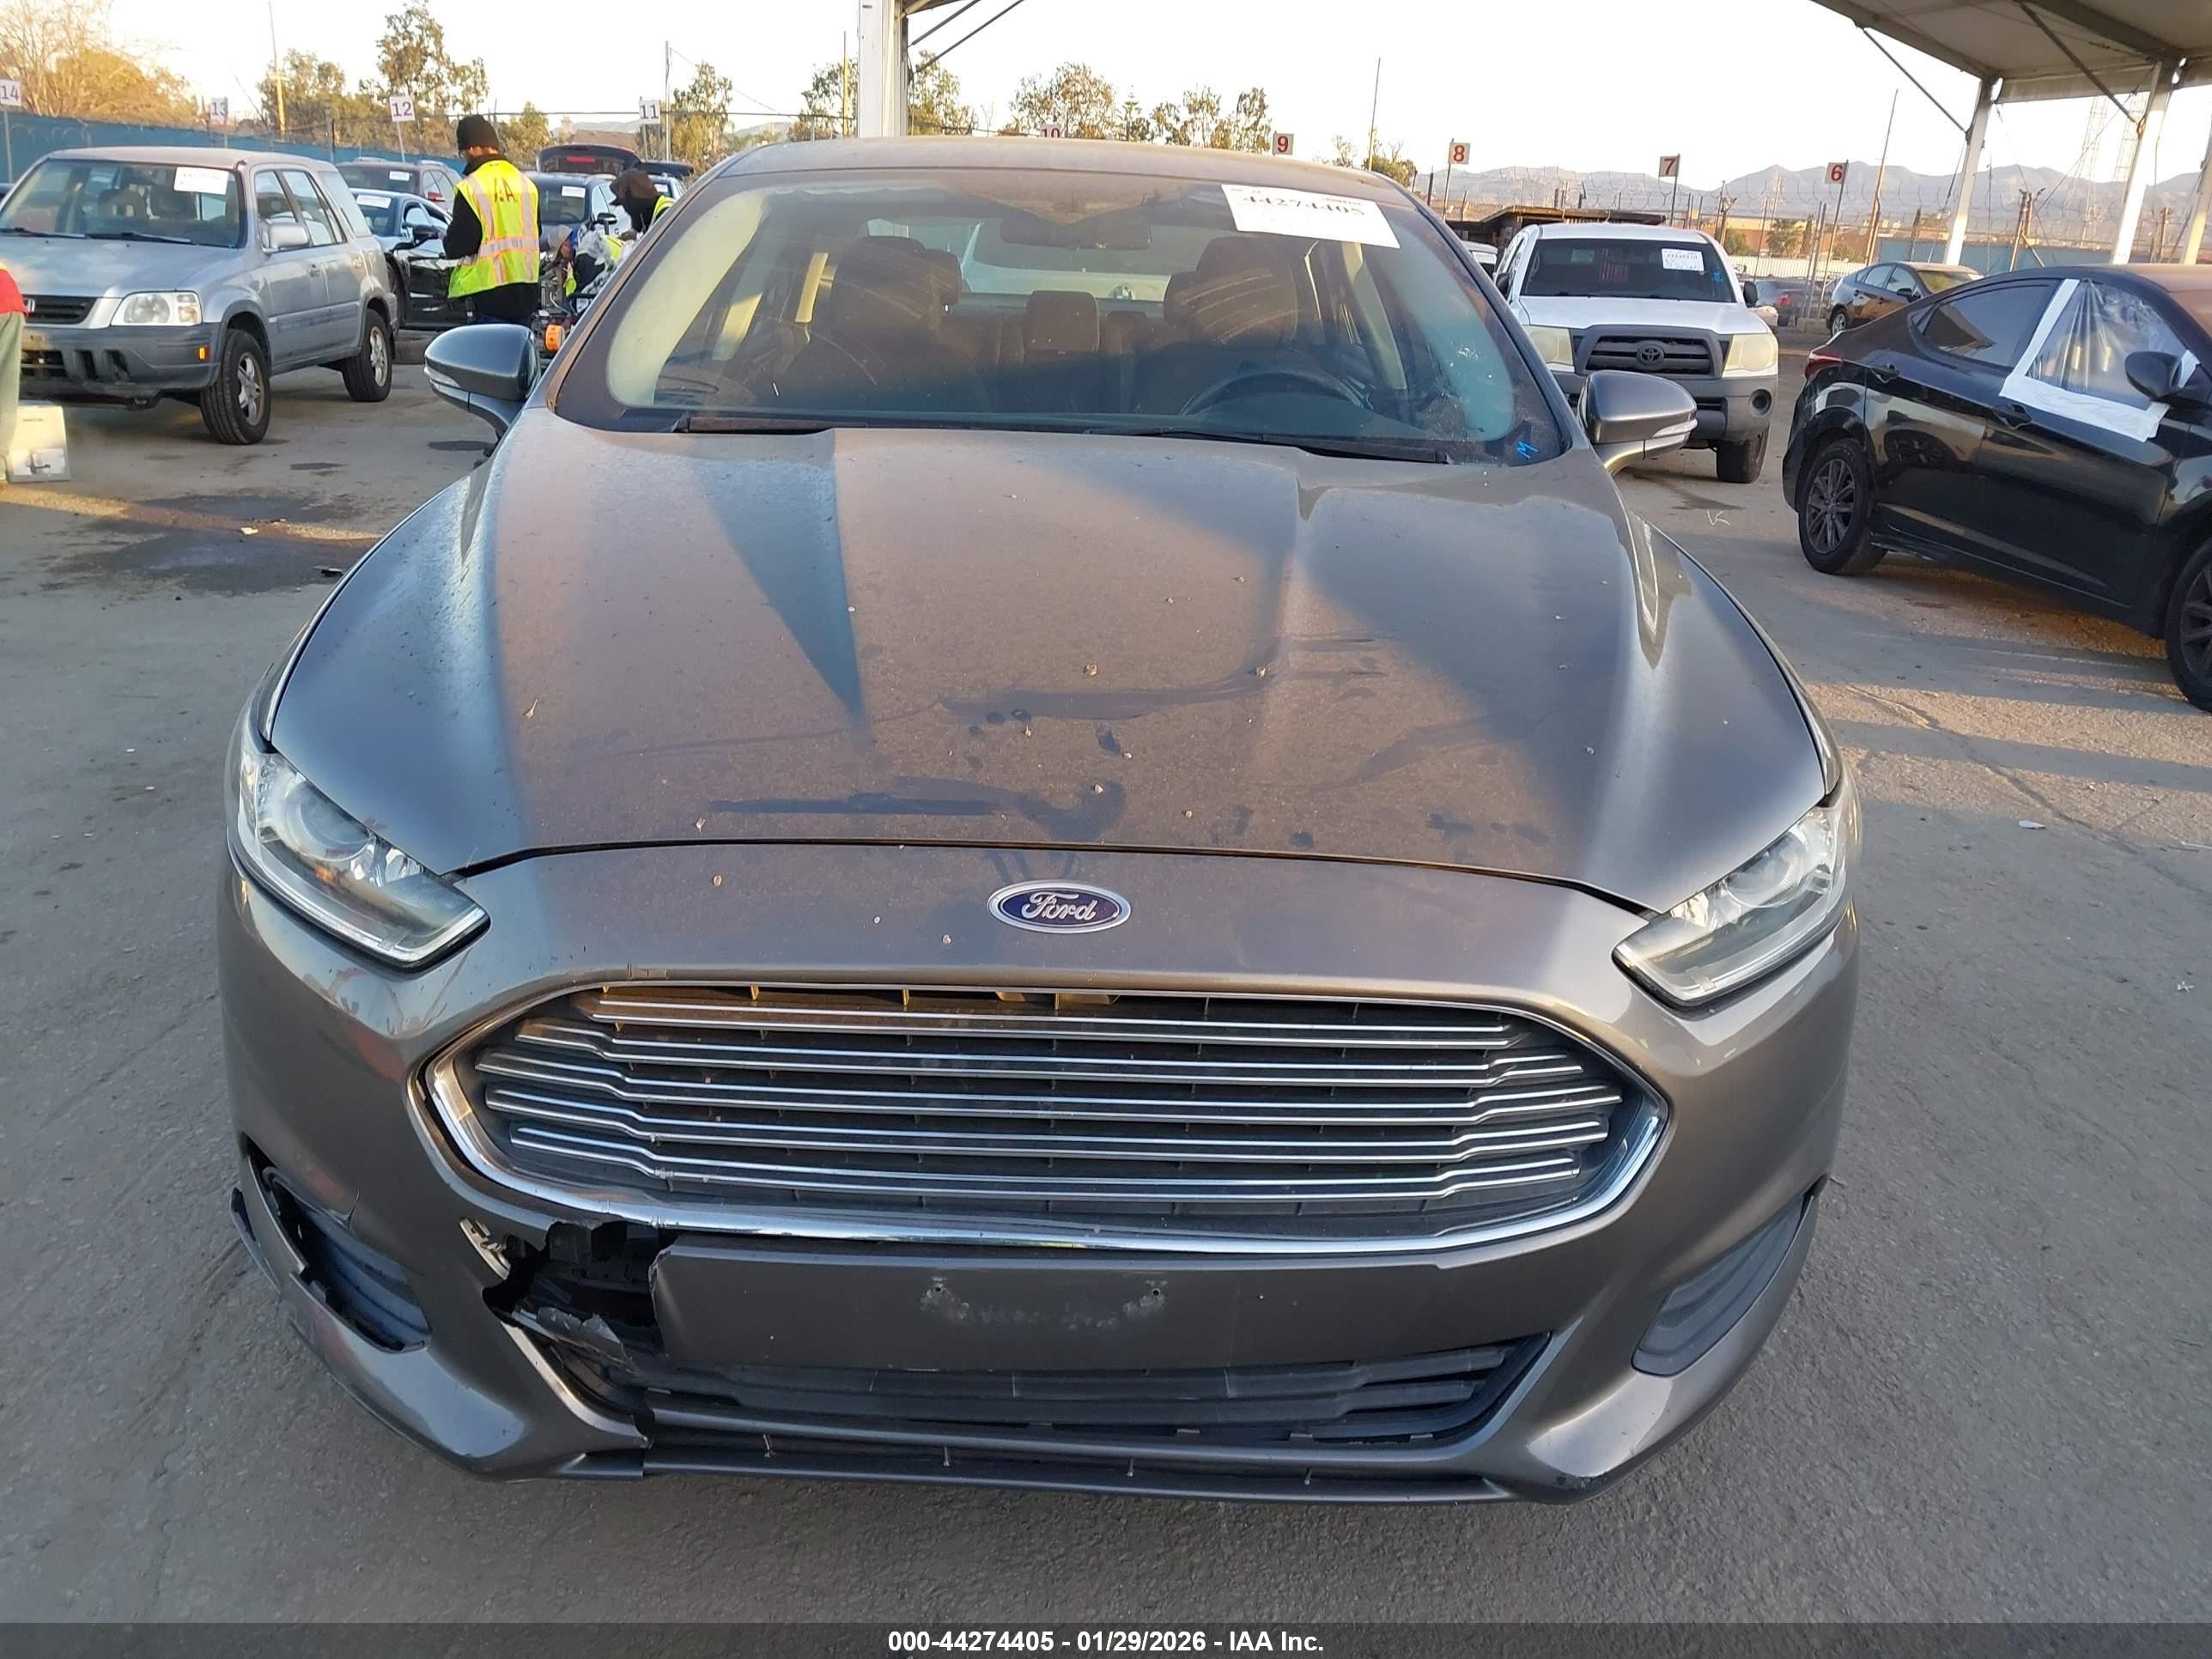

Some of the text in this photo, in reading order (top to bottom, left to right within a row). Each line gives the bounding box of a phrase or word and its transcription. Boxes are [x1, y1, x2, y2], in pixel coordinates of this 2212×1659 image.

[1, 85, 19, 100] 14
[392, 101, 413, 117] 12
[640, 104, 659, 119] 11
[1277, 136, 1289, 153] 9
[1453, 144, 1465, 162] 8
[1664, 157, 1677, 175] 7
[1831, 164, 1843, 181] 6
[1021, 891, 1098, 921] Ford
